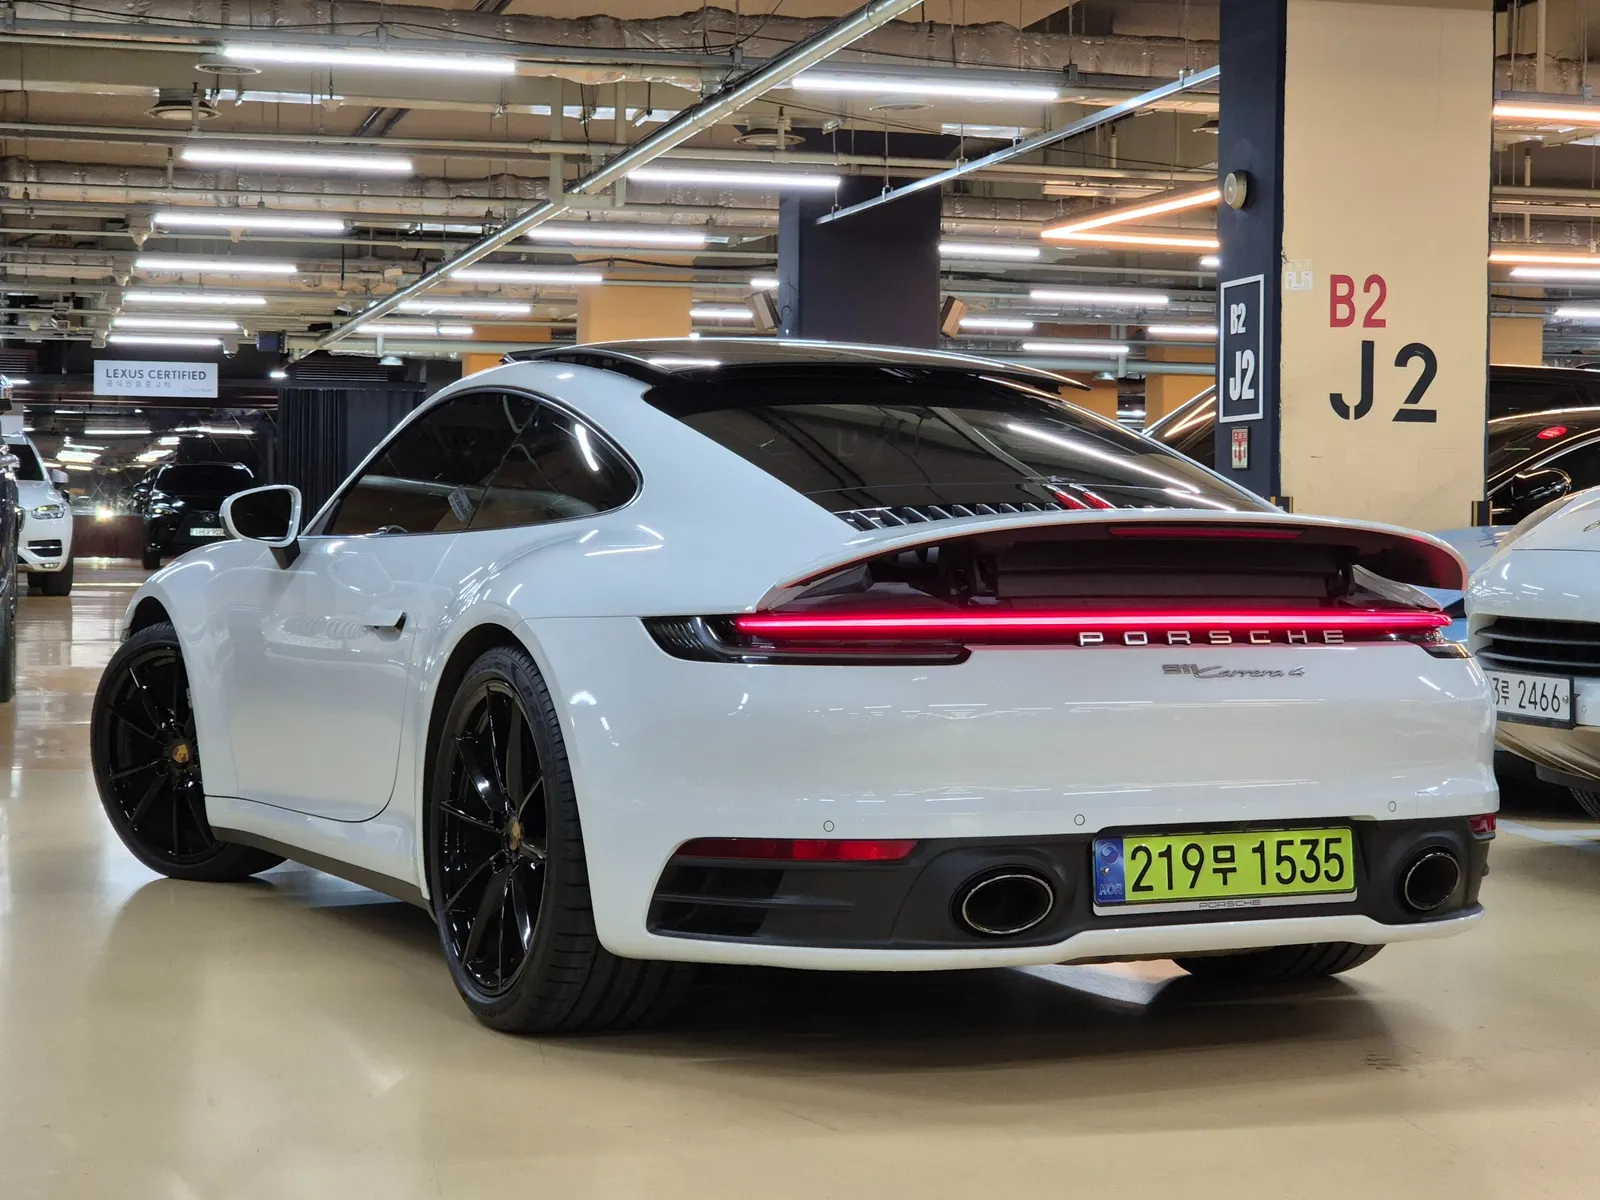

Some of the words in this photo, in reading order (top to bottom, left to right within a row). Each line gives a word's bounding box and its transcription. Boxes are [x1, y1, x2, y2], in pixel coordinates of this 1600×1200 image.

[1329, 274, 1387, 328] B2
[1230, 302, 1247, 335] B2
[105, 368, 144, 379] LEXUS
[148, 369, 207, 380] CERTIFIED
[1229, 349, 1255, 401] J2
[1329, 340, 1437, 423] J2
[1078, 630, 1345, 646] PORSCHE
[1162, 664, 1199, 675] 911
[1194, 665, 1285, 679] Carrera
[1289, 666, 1305, 677] 4
[1518, 680, 1561, 713] 2466
[1130, 843, 1237, 893] 219무
[1251, 837, 1344, 886] 1535
[1099, 882, 1123, 896] KOR
[1199, 899, 1261, 909] PORSCHE
